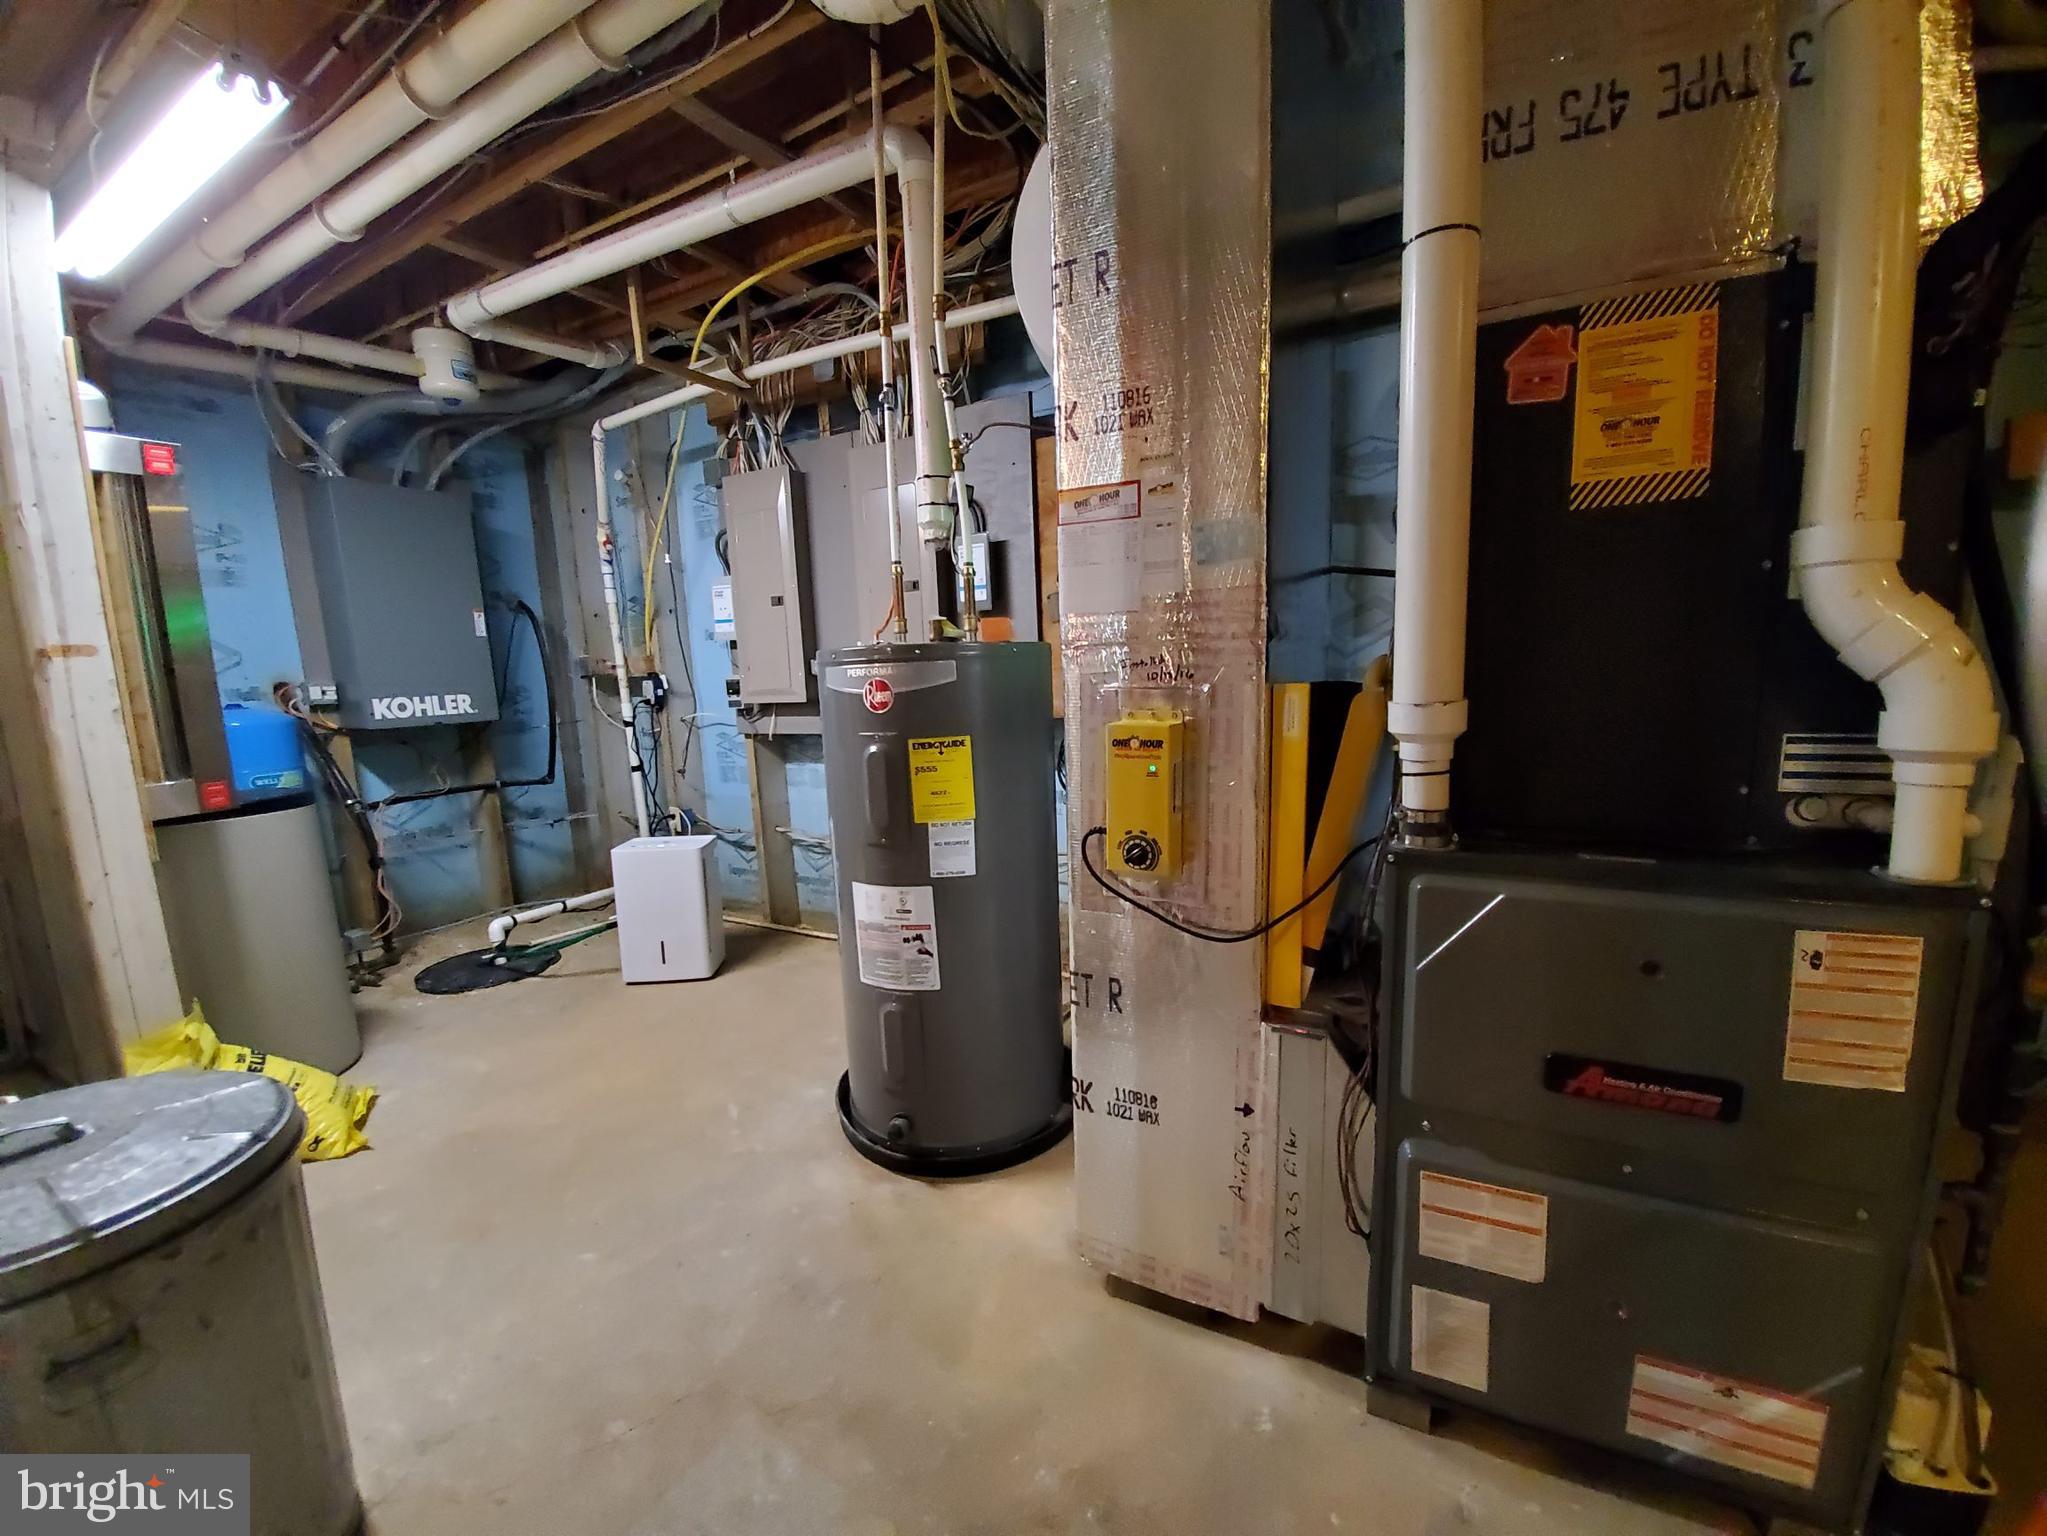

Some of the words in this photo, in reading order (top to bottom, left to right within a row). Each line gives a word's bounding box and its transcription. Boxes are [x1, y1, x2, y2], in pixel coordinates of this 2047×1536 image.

[1658, 44, 1760, 120] TYPE
[1560, 78, 1631, 142] 475
[371, 694, 474, 720] KOHLER
[1111, 738, 1130, 749] ONE
[1139, 738, 1164, 750] HOUR
[1108, 976, 1123, 1015] R
[1107, 1101, 1134, 1121] 1021
